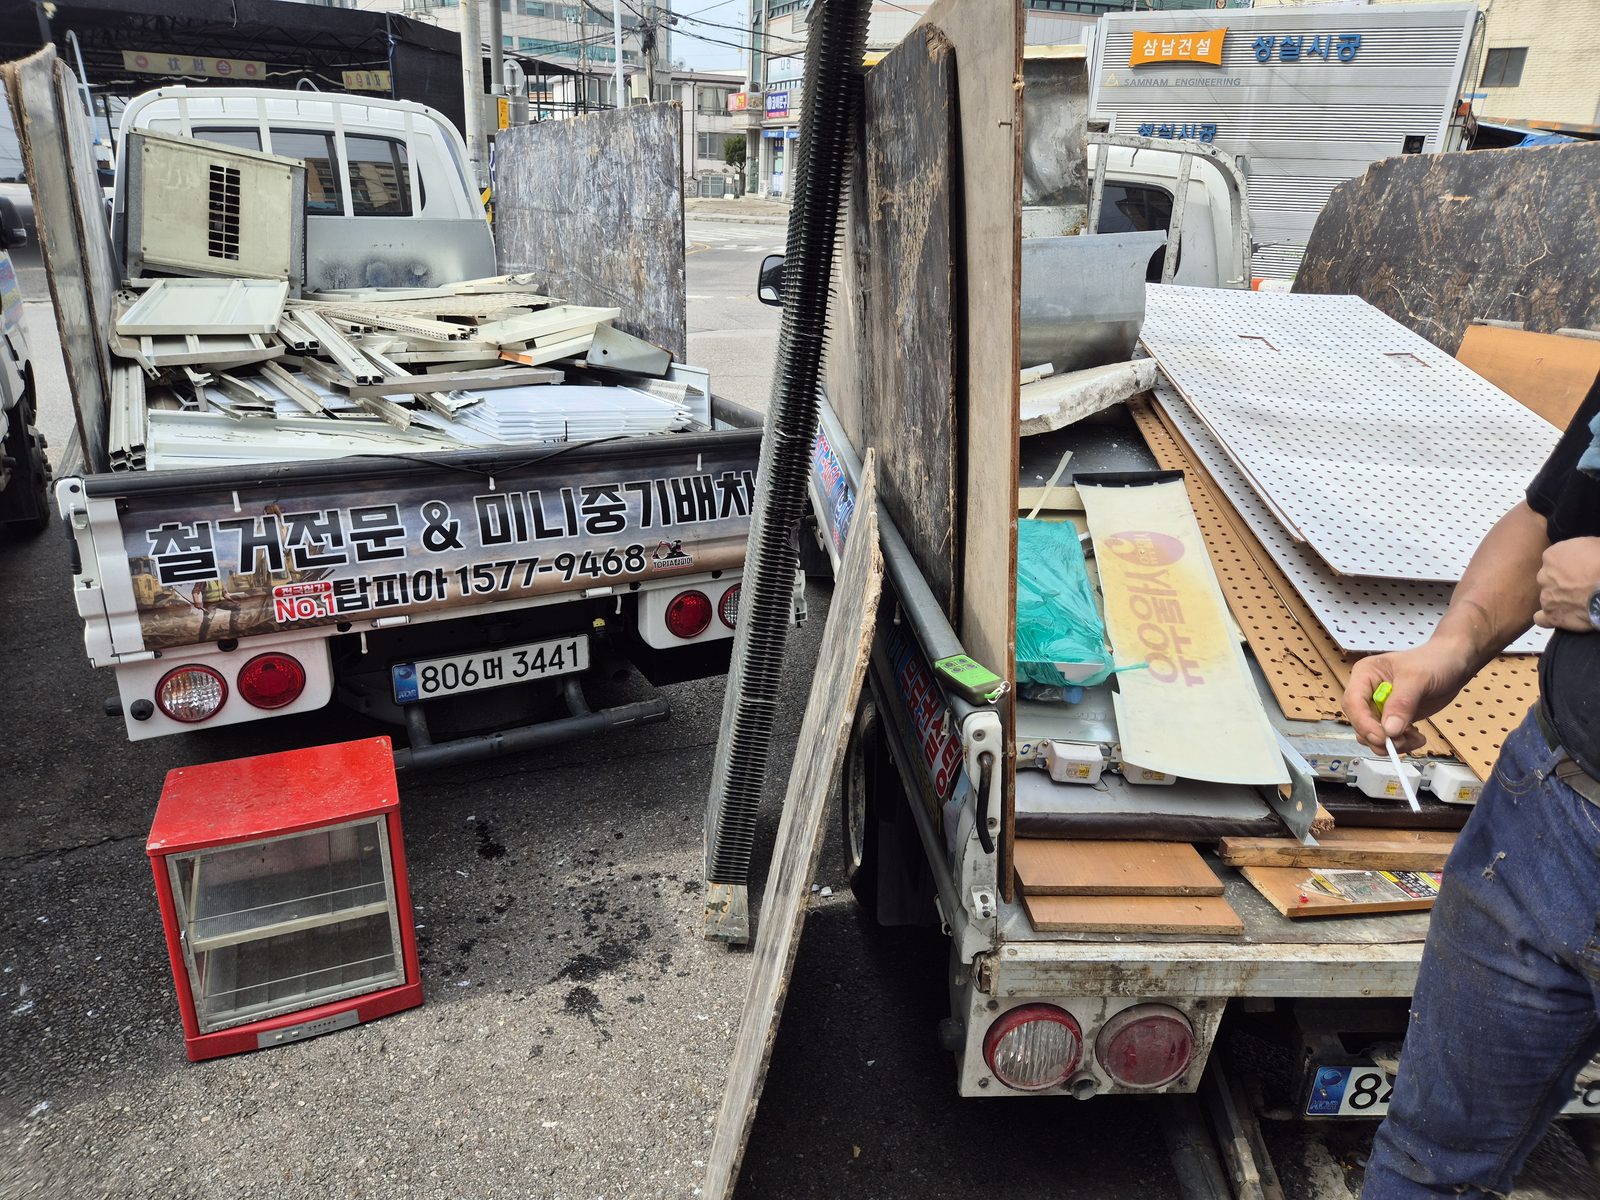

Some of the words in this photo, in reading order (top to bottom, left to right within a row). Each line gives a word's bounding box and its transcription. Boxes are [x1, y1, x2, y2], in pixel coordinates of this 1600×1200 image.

[1143, 38, 1211, 56] 삼남건설
[1252, 34, 1361, 62] 성실시공
[1124, 78, 1169, 87] SAMNAM
[1175, 77, 1241, 87] ENGINEERING
[147, 503, 406, 586] 철거전문
[421, 499, 464, 554] &
[274, 591, 335, 622] No.1
[333, 567, 447, 615] 탑피아
[455, 542, 646, 597] 1577-9468
[421, 656, 503, 693] 806머
[512, 641, 578, 678] 3441
